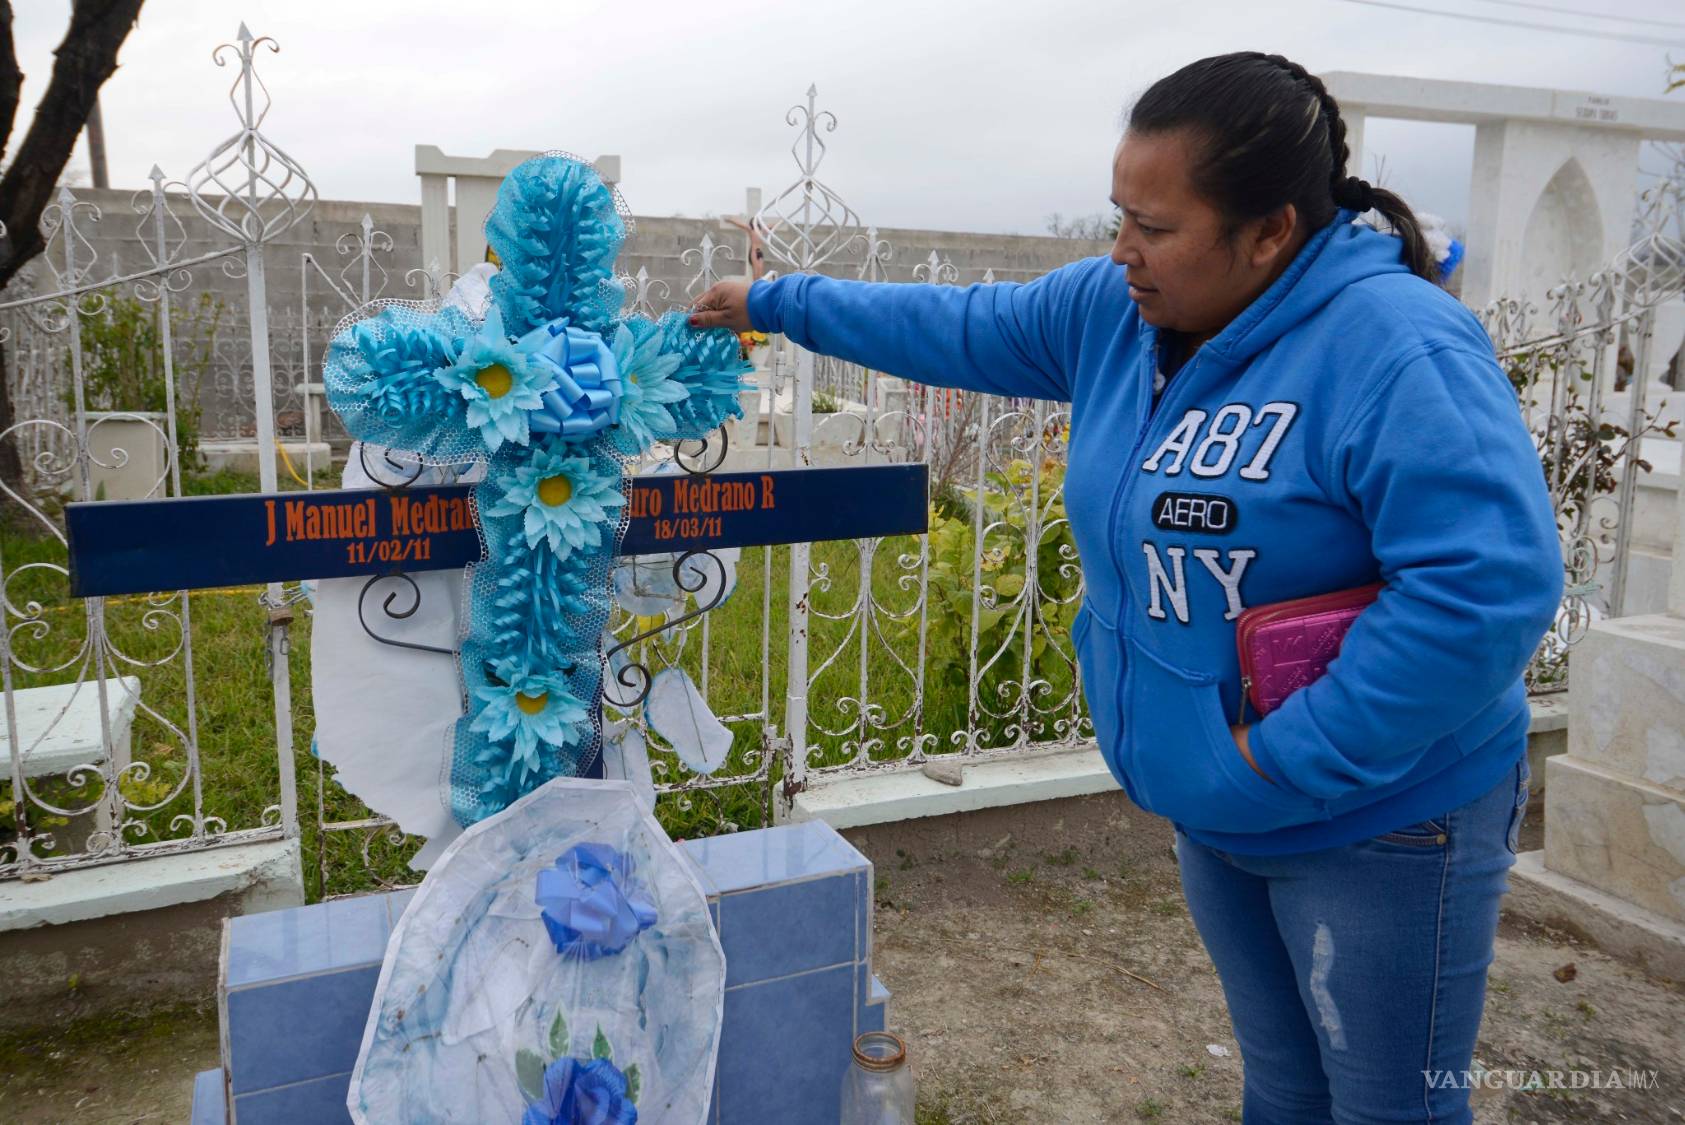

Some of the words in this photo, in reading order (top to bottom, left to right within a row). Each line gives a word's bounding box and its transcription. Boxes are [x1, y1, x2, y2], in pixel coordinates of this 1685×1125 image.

[1141, 401, 1298, 480] A87
[673, 478, 755, 513] Medrano
[761, 475, 775, 509] R
[265, 500, 276, 546] J
[285, 499, 376, 541] Manuel
[655, 517, 722, 539] 18/03/11
[1158, 498, 1228, 529] AERO
[347, 537, 430, 564] 11/02/11
[1143, 543, 1256, 623] NY
